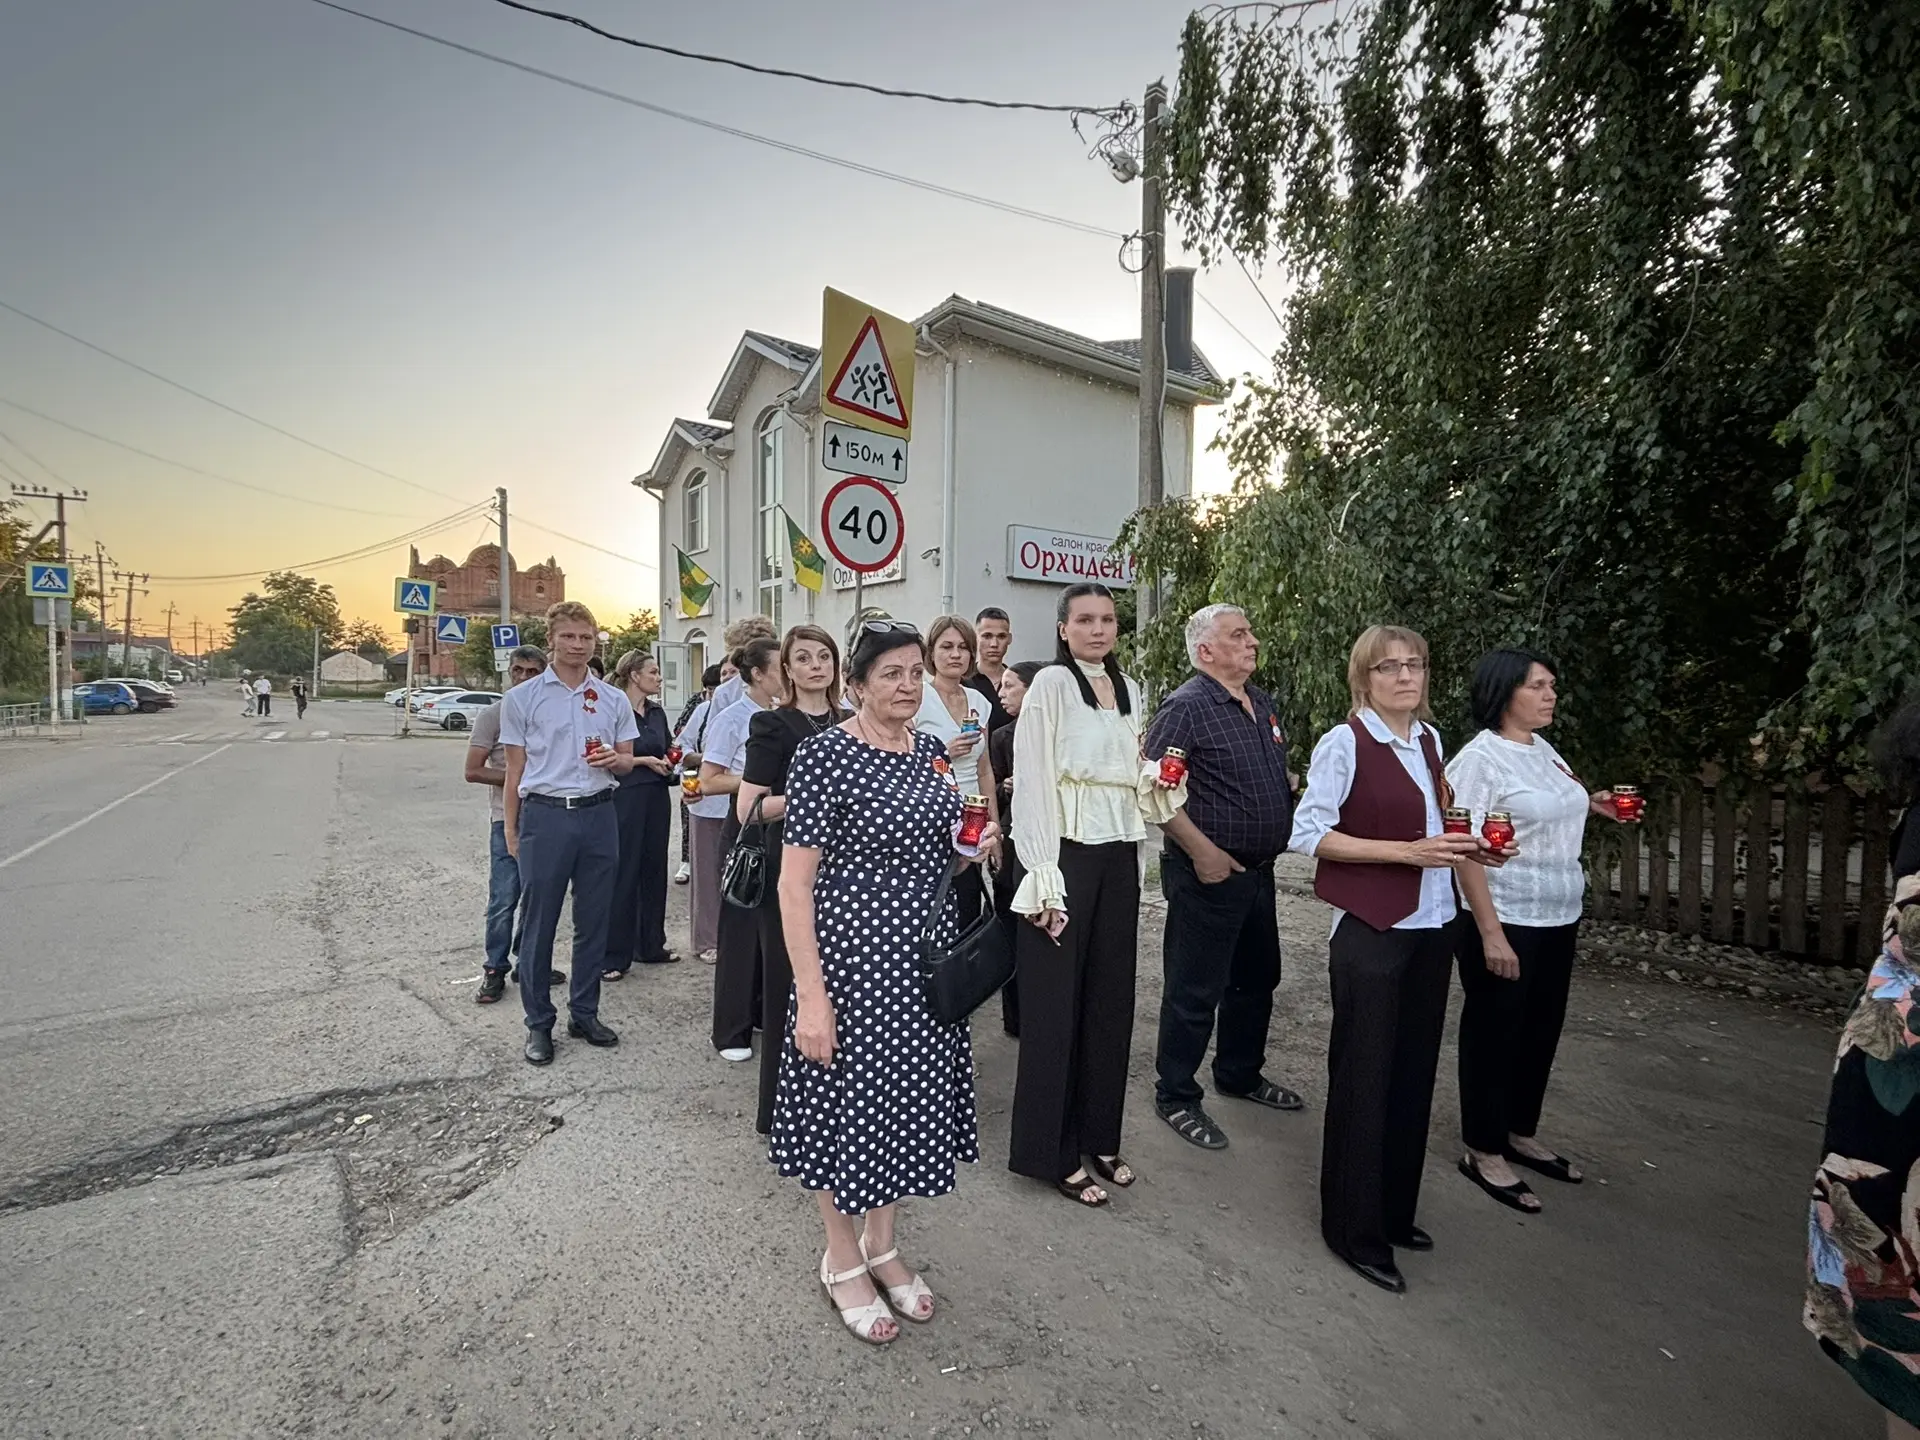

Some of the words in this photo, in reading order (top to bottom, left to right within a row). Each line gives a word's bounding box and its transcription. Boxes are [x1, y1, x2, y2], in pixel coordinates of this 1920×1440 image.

[838, 505, 888, 545] 40
[1051, 536, 1083, 550] салон
[1085, 541, 1113, 555] крас
[1020, 541, 1124, 580] Орхидея
[499, 627, 514, 646] P
